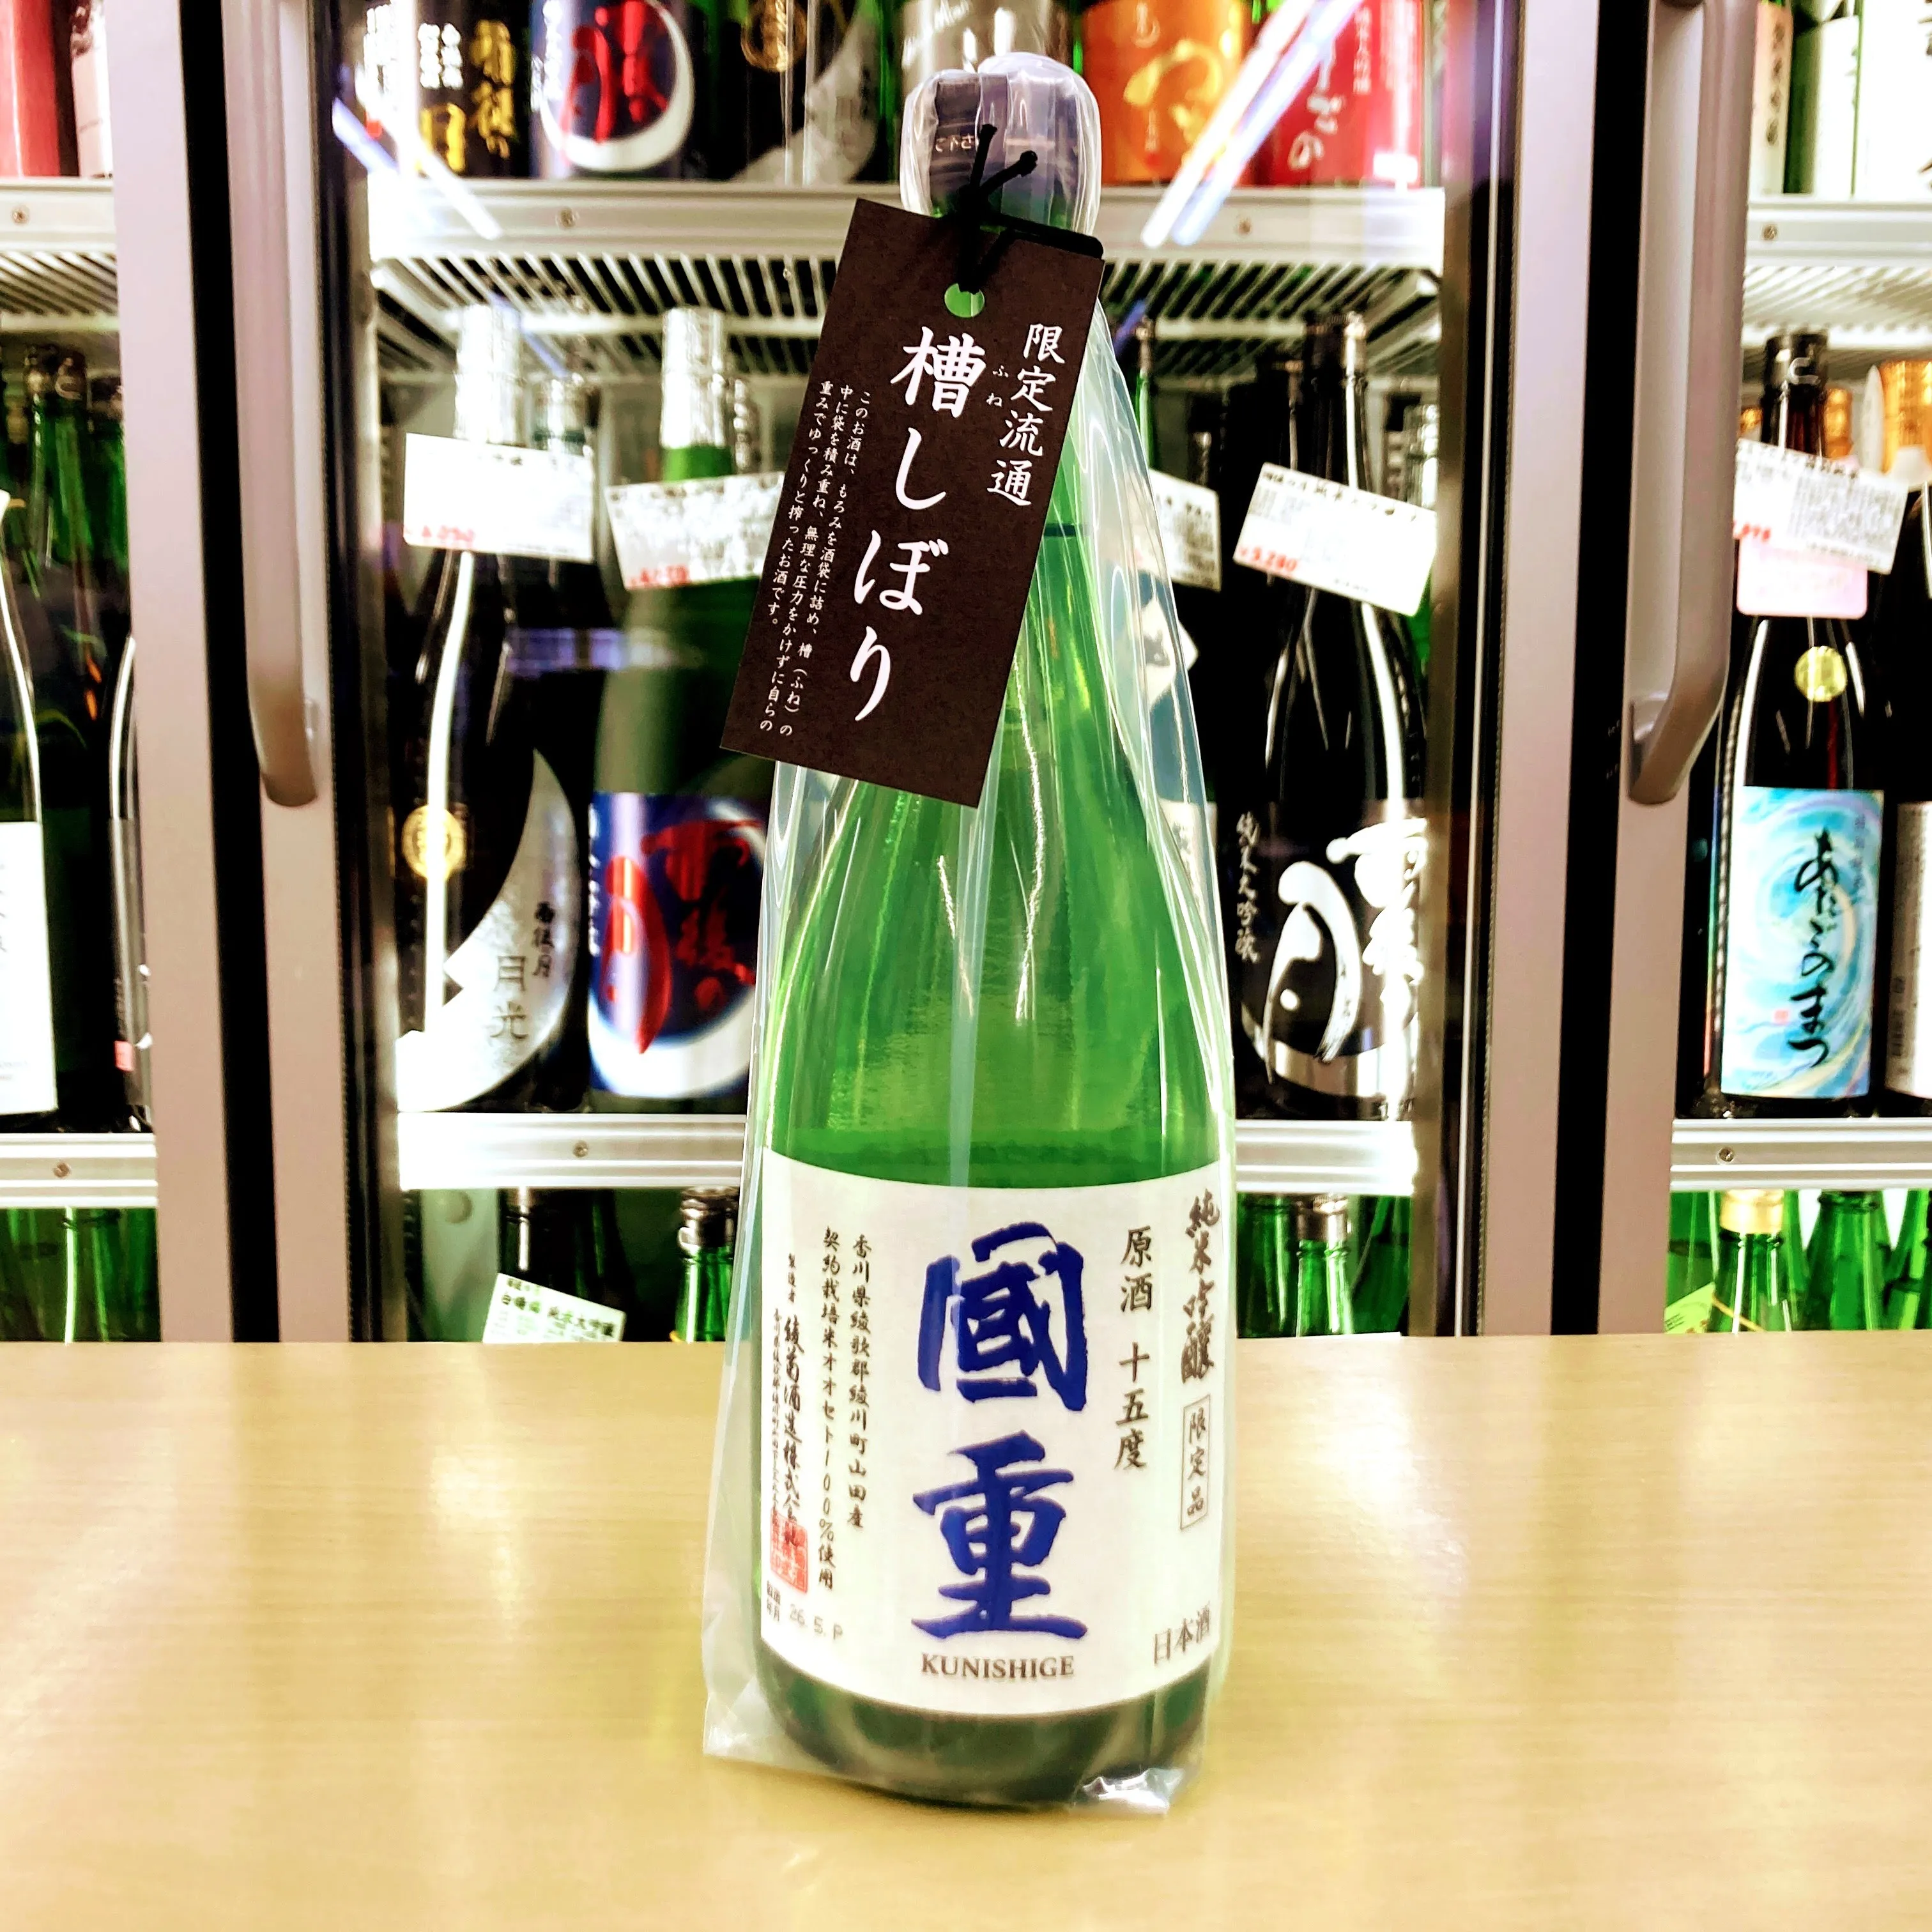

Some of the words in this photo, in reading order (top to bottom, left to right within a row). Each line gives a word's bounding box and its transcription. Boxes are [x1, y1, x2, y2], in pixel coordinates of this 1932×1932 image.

[986, 365, 1009, 408] ふね
[987, 323, 1066, 507] 限定流通
[850, 326, 986, 721] 槽しぼり
[1119, 1225, 1153, 1313] 原酒
[911, 1221, 1088, 1639] 國重
[1114, 1341, 1151, 1471] 十五度
[1186, 1406, 1206, 1517] 限定品
[921, 1652, 1075, 1682] KUNISHIGE
[1153, 1601, 1211, 1666] 日本酒
